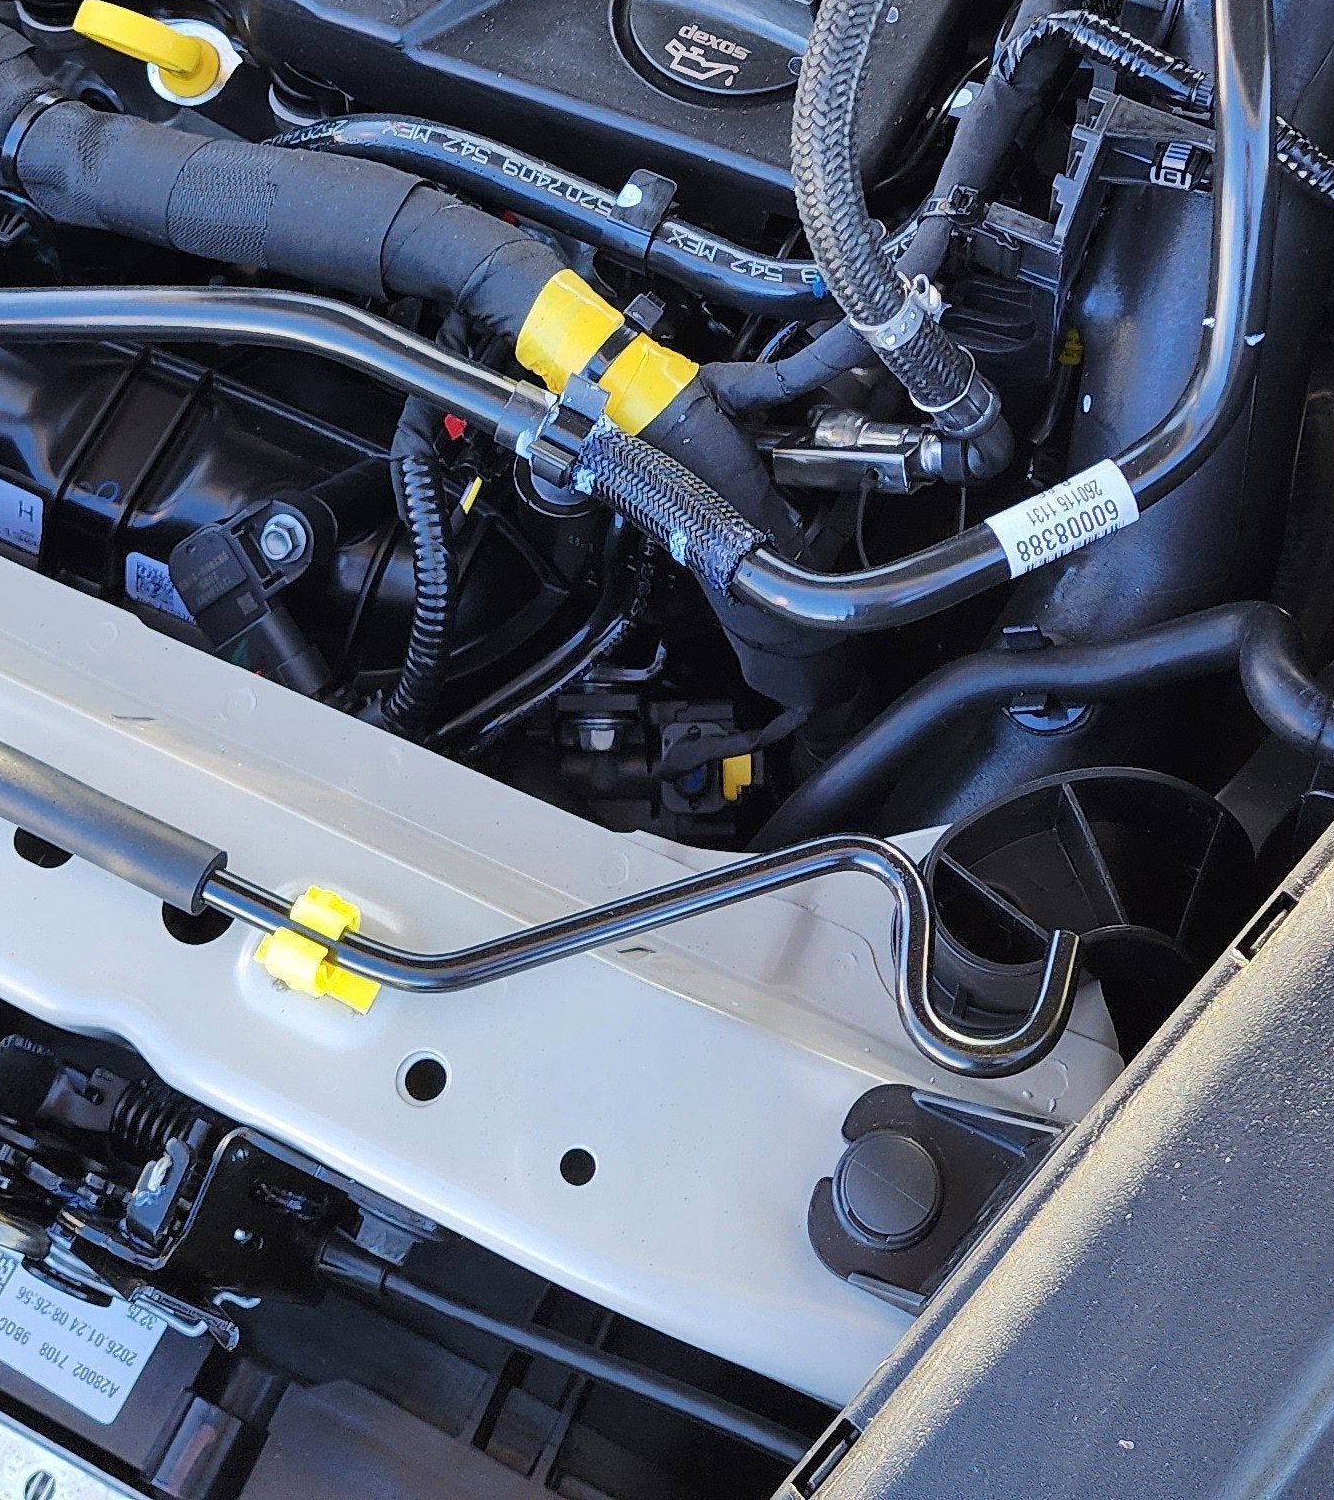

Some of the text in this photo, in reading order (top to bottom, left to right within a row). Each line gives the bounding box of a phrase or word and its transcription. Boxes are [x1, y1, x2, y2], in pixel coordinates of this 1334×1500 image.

[678, 24, 752, 61] dexos
[382, 120, 434, 144] MEX
[441, 138, 494, 167] 542
[666, 225, 719, 261] MEX
[730, 253, 784, 284] 542
[18, 500, 35, 523] H
[1026, 496, 1057, 526] 1131
[1056, 479, 1103, 513] 260115
[1016, 500, 1119, 562] 60008388
[16, 1285, 138, 1367] 2026.01.24 08:26:56
[38, 1341, 72, 1369] 7108
[71, 1362, 120, 1399] A28002
